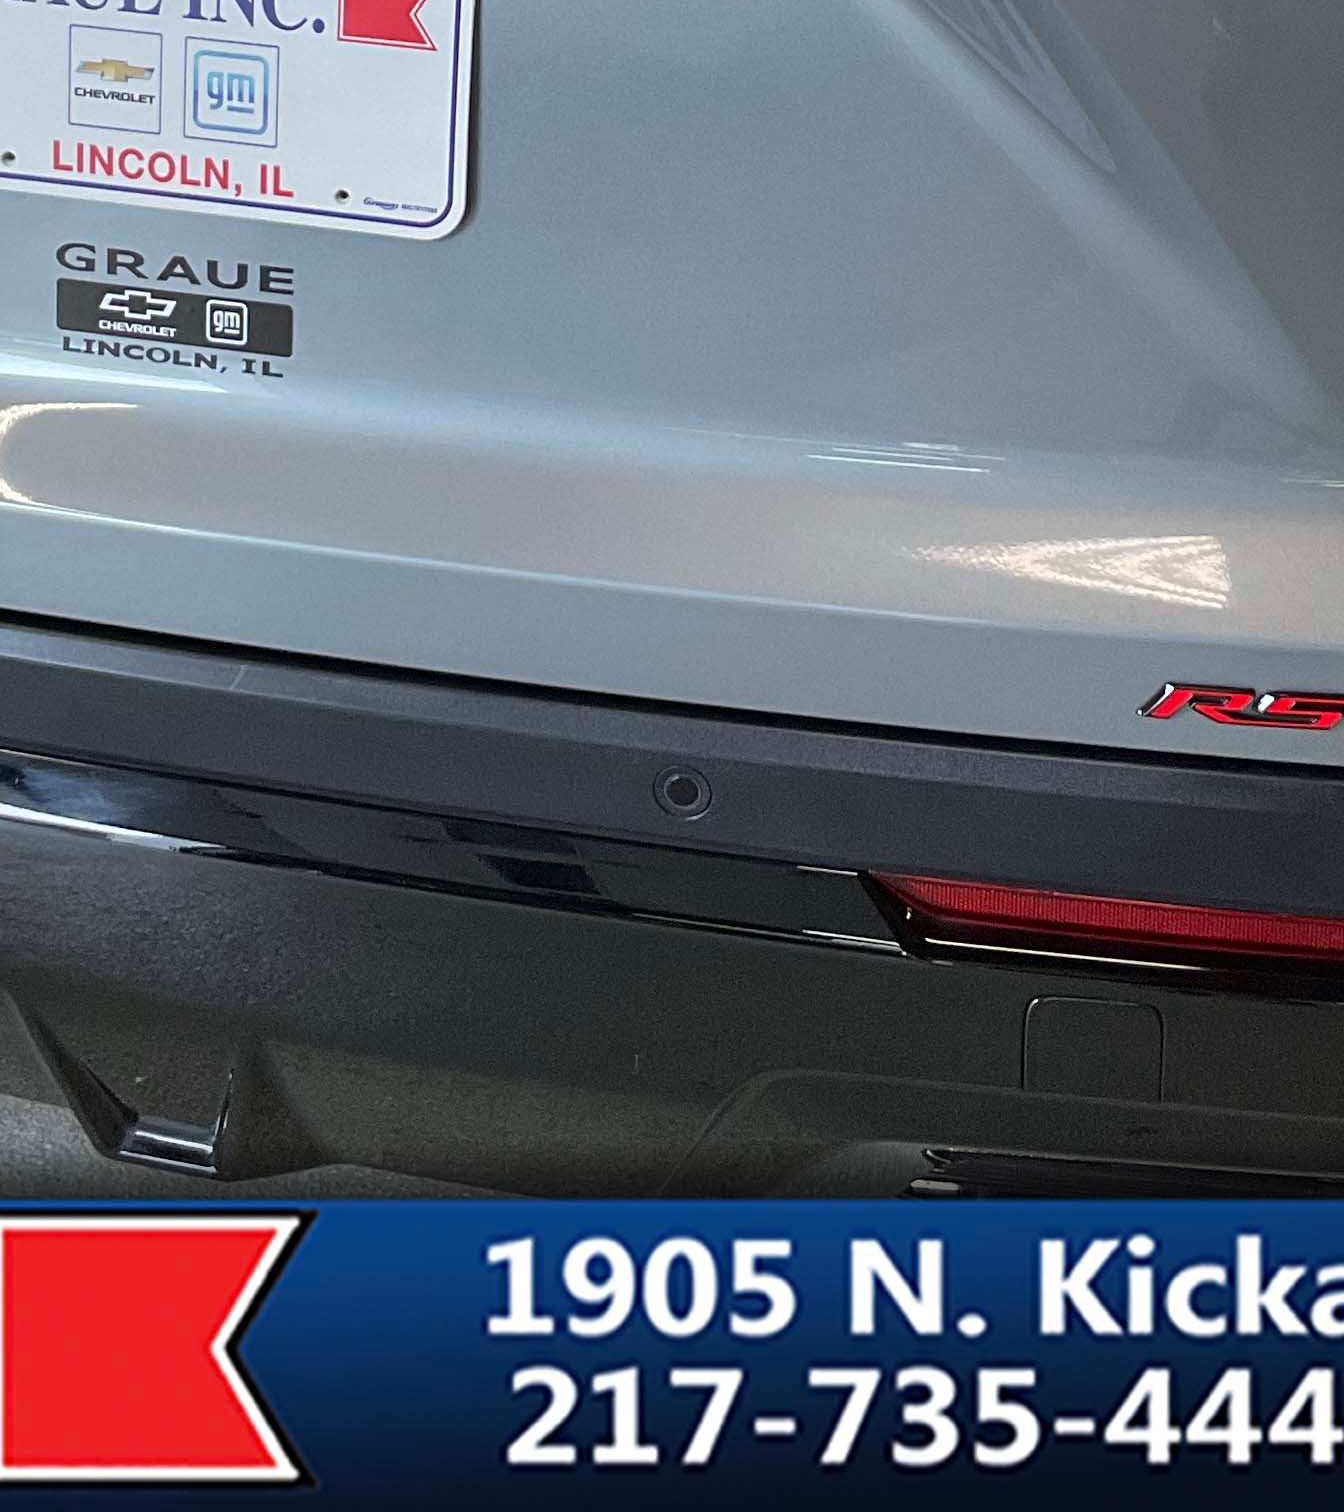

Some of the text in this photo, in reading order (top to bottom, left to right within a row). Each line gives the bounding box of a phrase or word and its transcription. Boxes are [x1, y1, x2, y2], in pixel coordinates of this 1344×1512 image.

[74, 86, 156, 105] CHEVROLET
[206, 71, 255, 115] gm
[52, 140, 295, 199] LINCOLN, IL
[56, 242, 296, 295] GRAUE
[98, 318, 177, 338] CHEVROLET
[213, 309, 241, 334] gm
[62, 335, 285, 378] LINCOLN, IL
